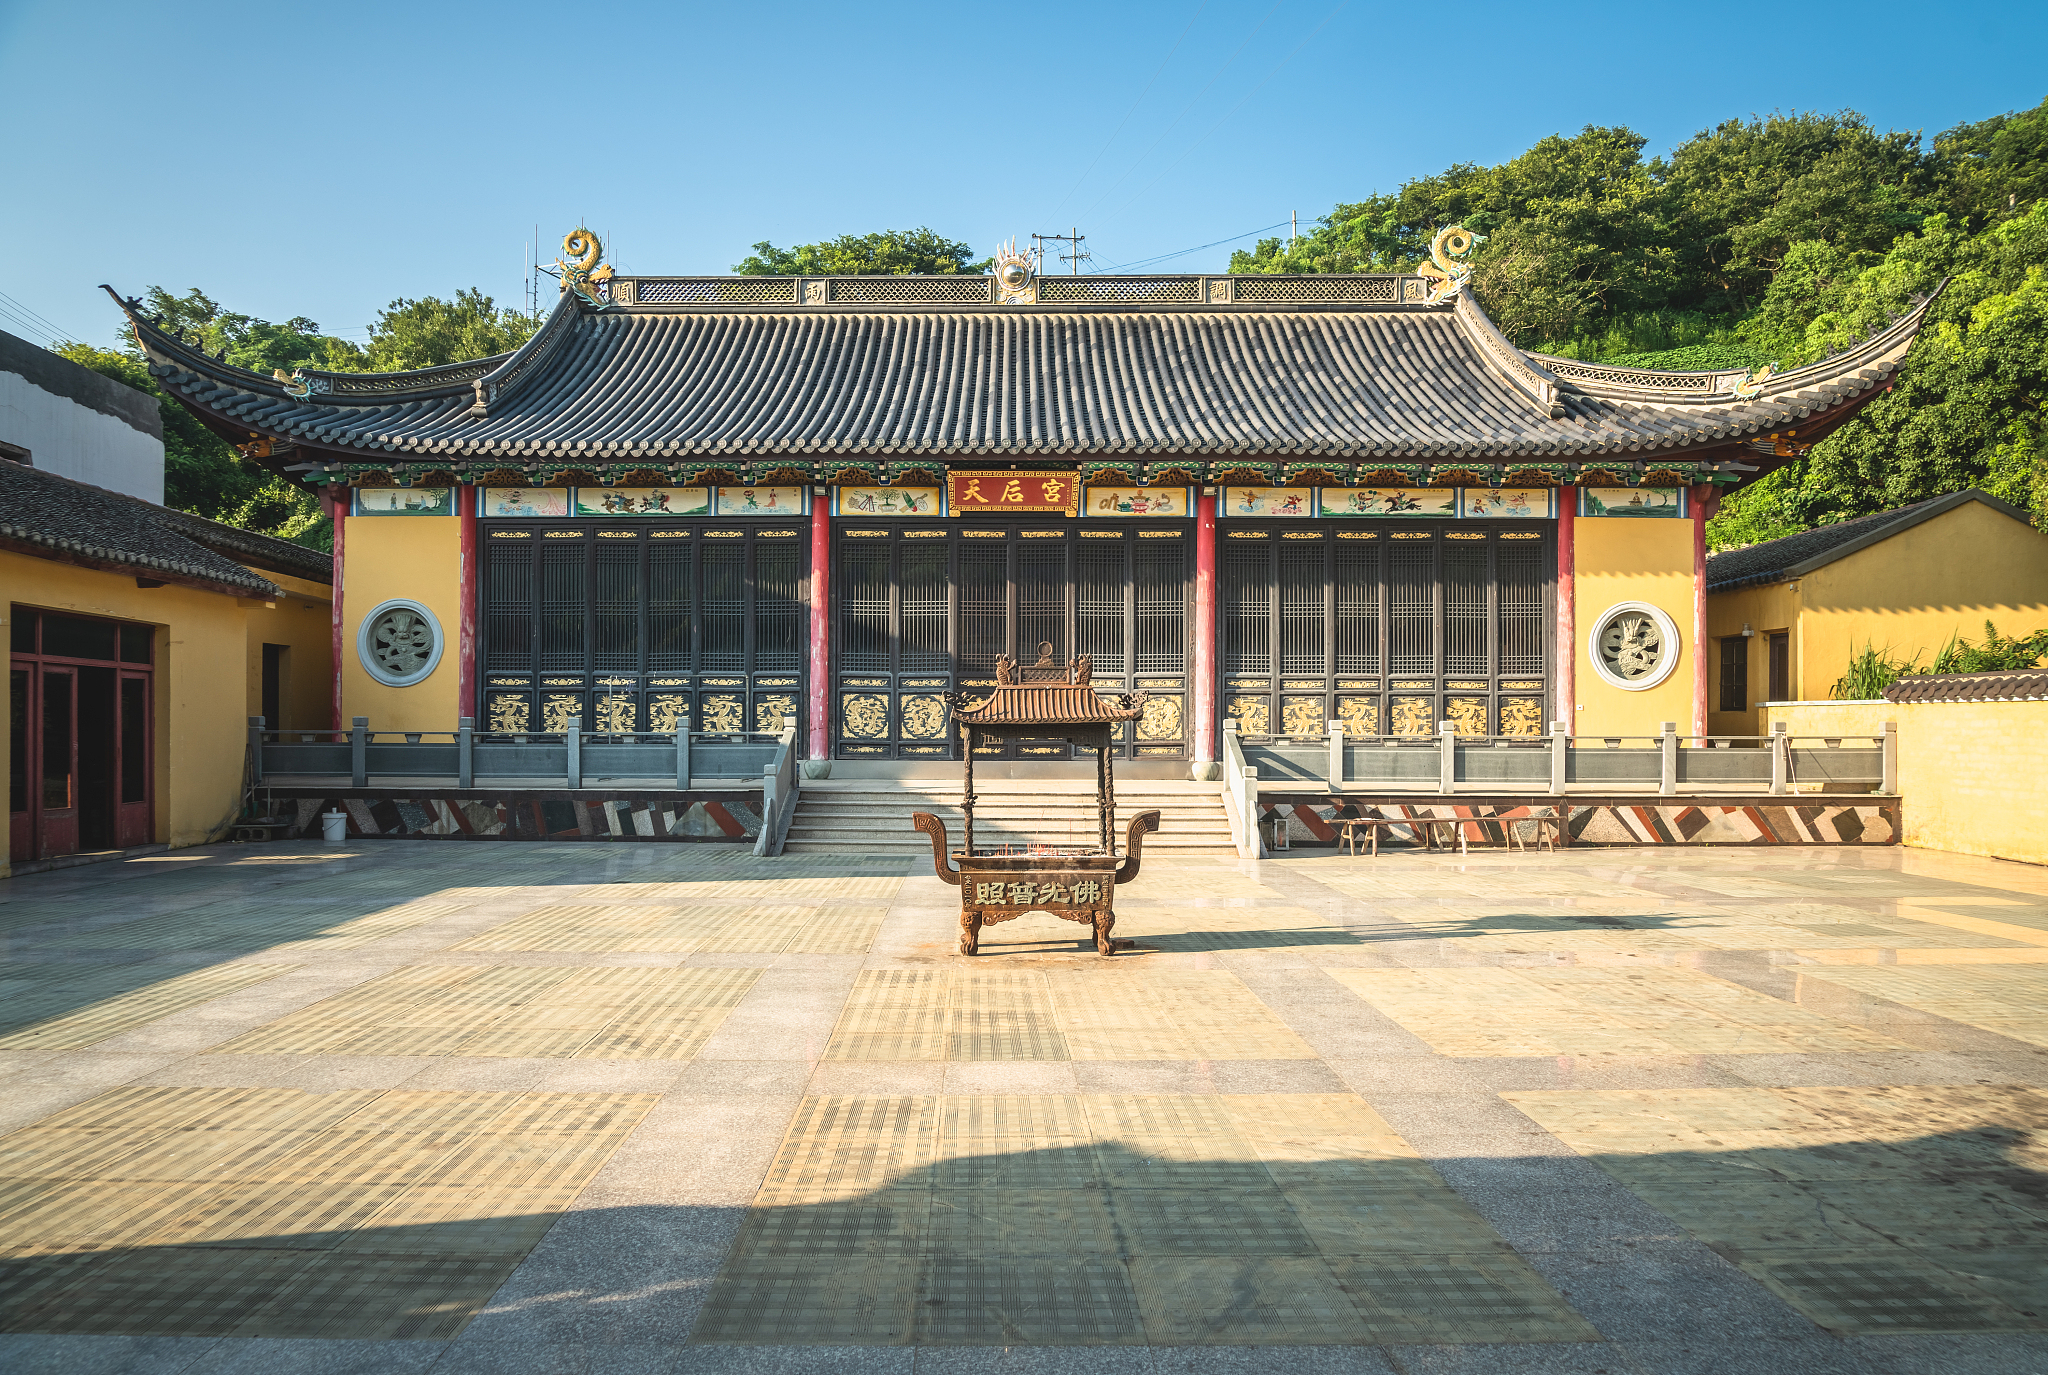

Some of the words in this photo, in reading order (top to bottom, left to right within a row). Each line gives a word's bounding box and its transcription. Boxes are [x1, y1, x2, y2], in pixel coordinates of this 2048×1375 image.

[612, 282, 630, 301] 順
[805, 282, 821, 300] 雨
[1209, 281, 1227, 299] 調
[1403, 281, 1423, 299] 風
